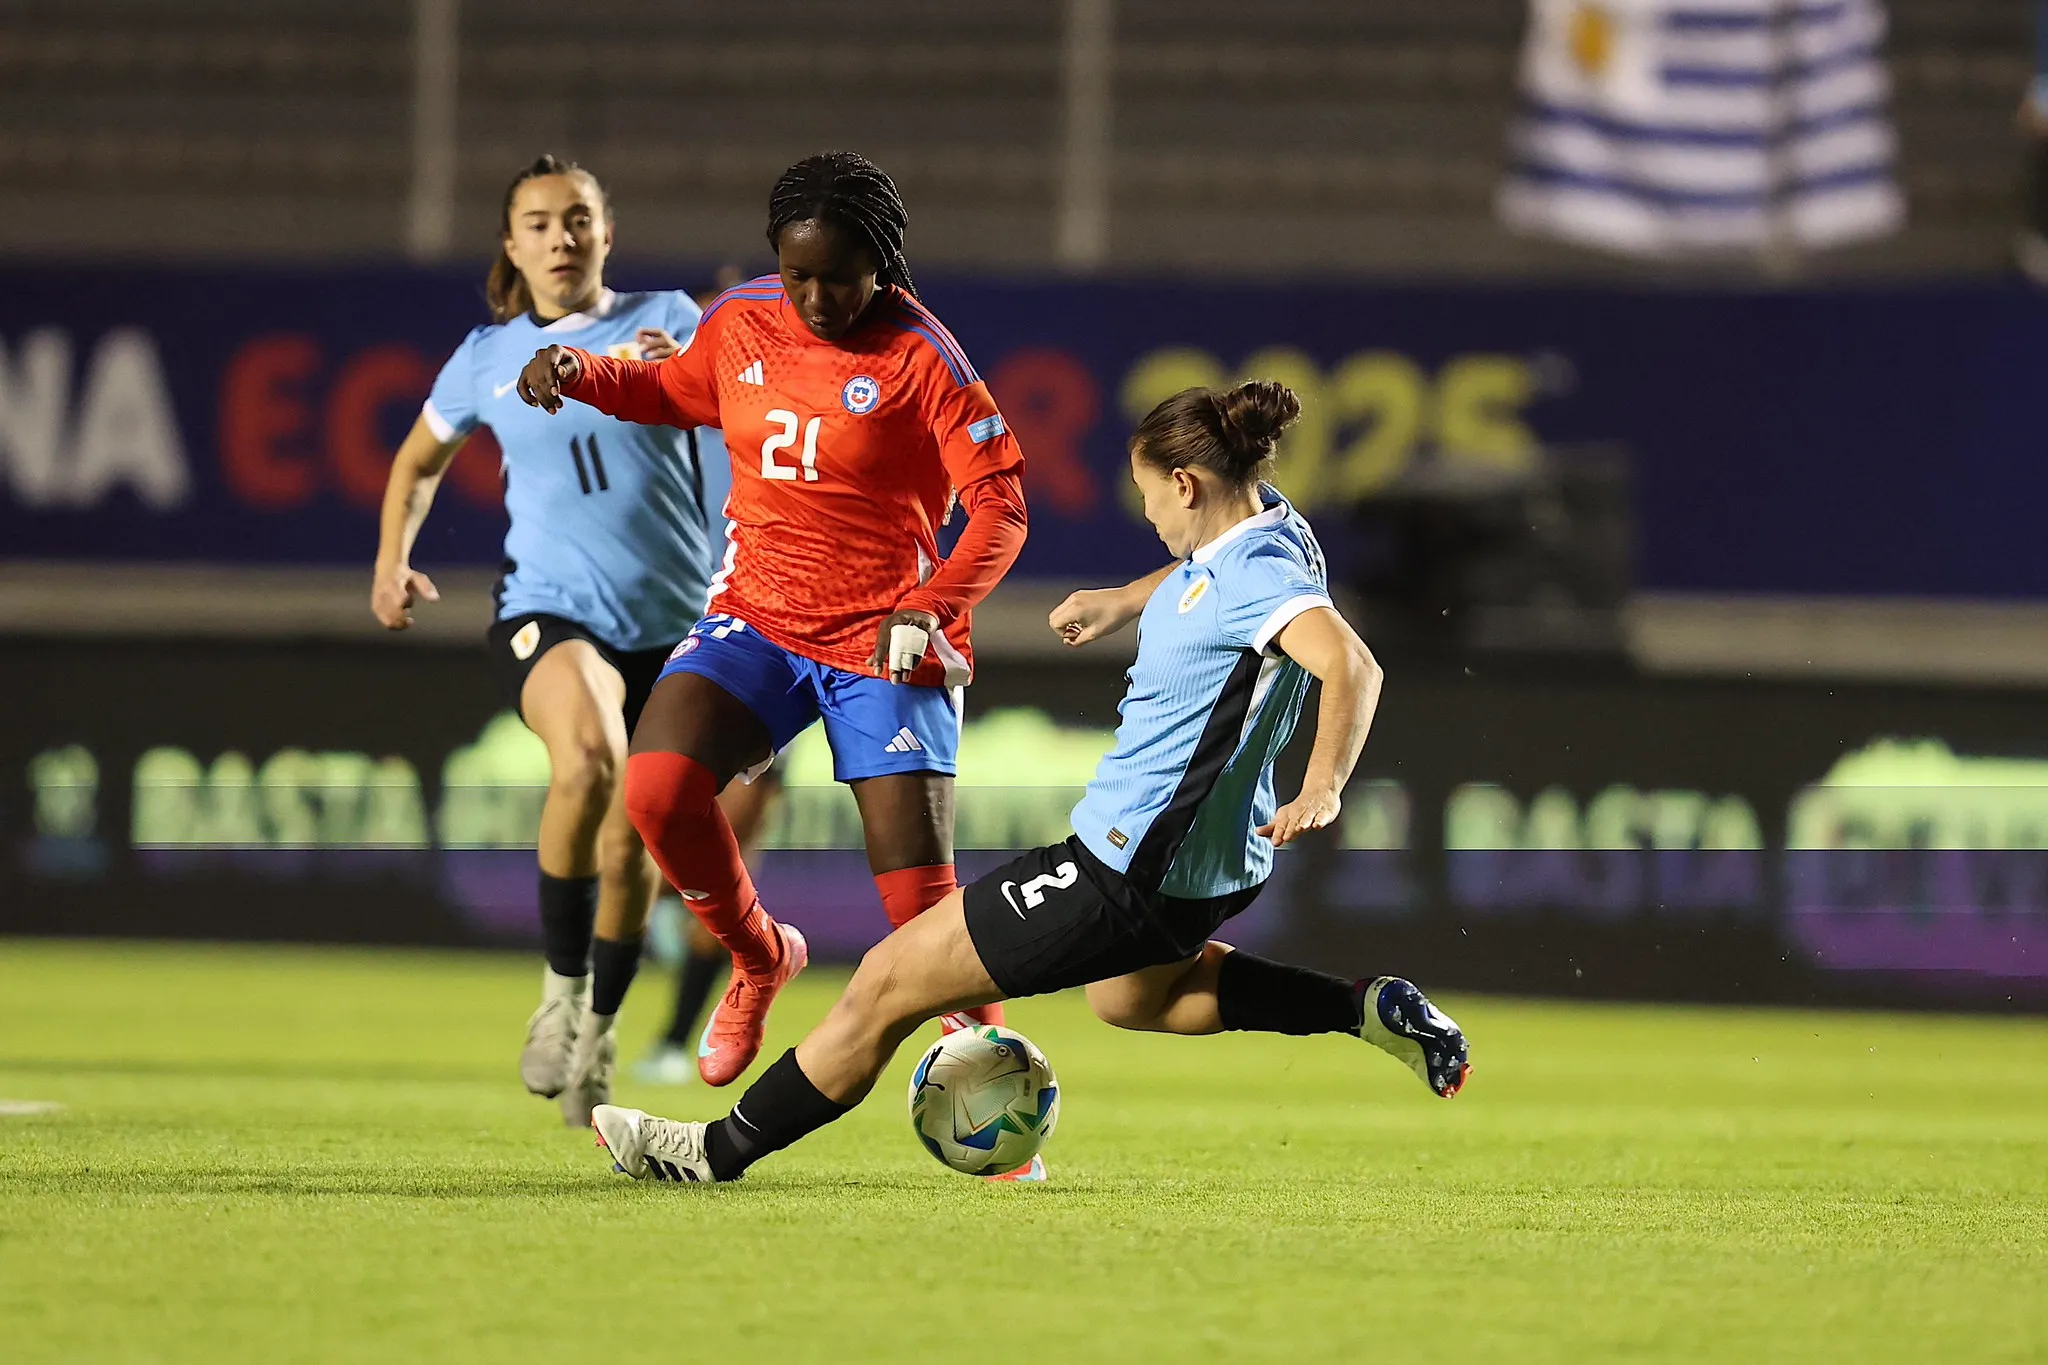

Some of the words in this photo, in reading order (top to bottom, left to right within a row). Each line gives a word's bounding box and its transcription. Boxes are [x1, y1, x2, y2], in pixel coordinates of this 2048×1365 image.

[569, 431, 609, 495] 11
[760, 408, 822, 482] 21
[1019, 860, 1080, 910] 2
